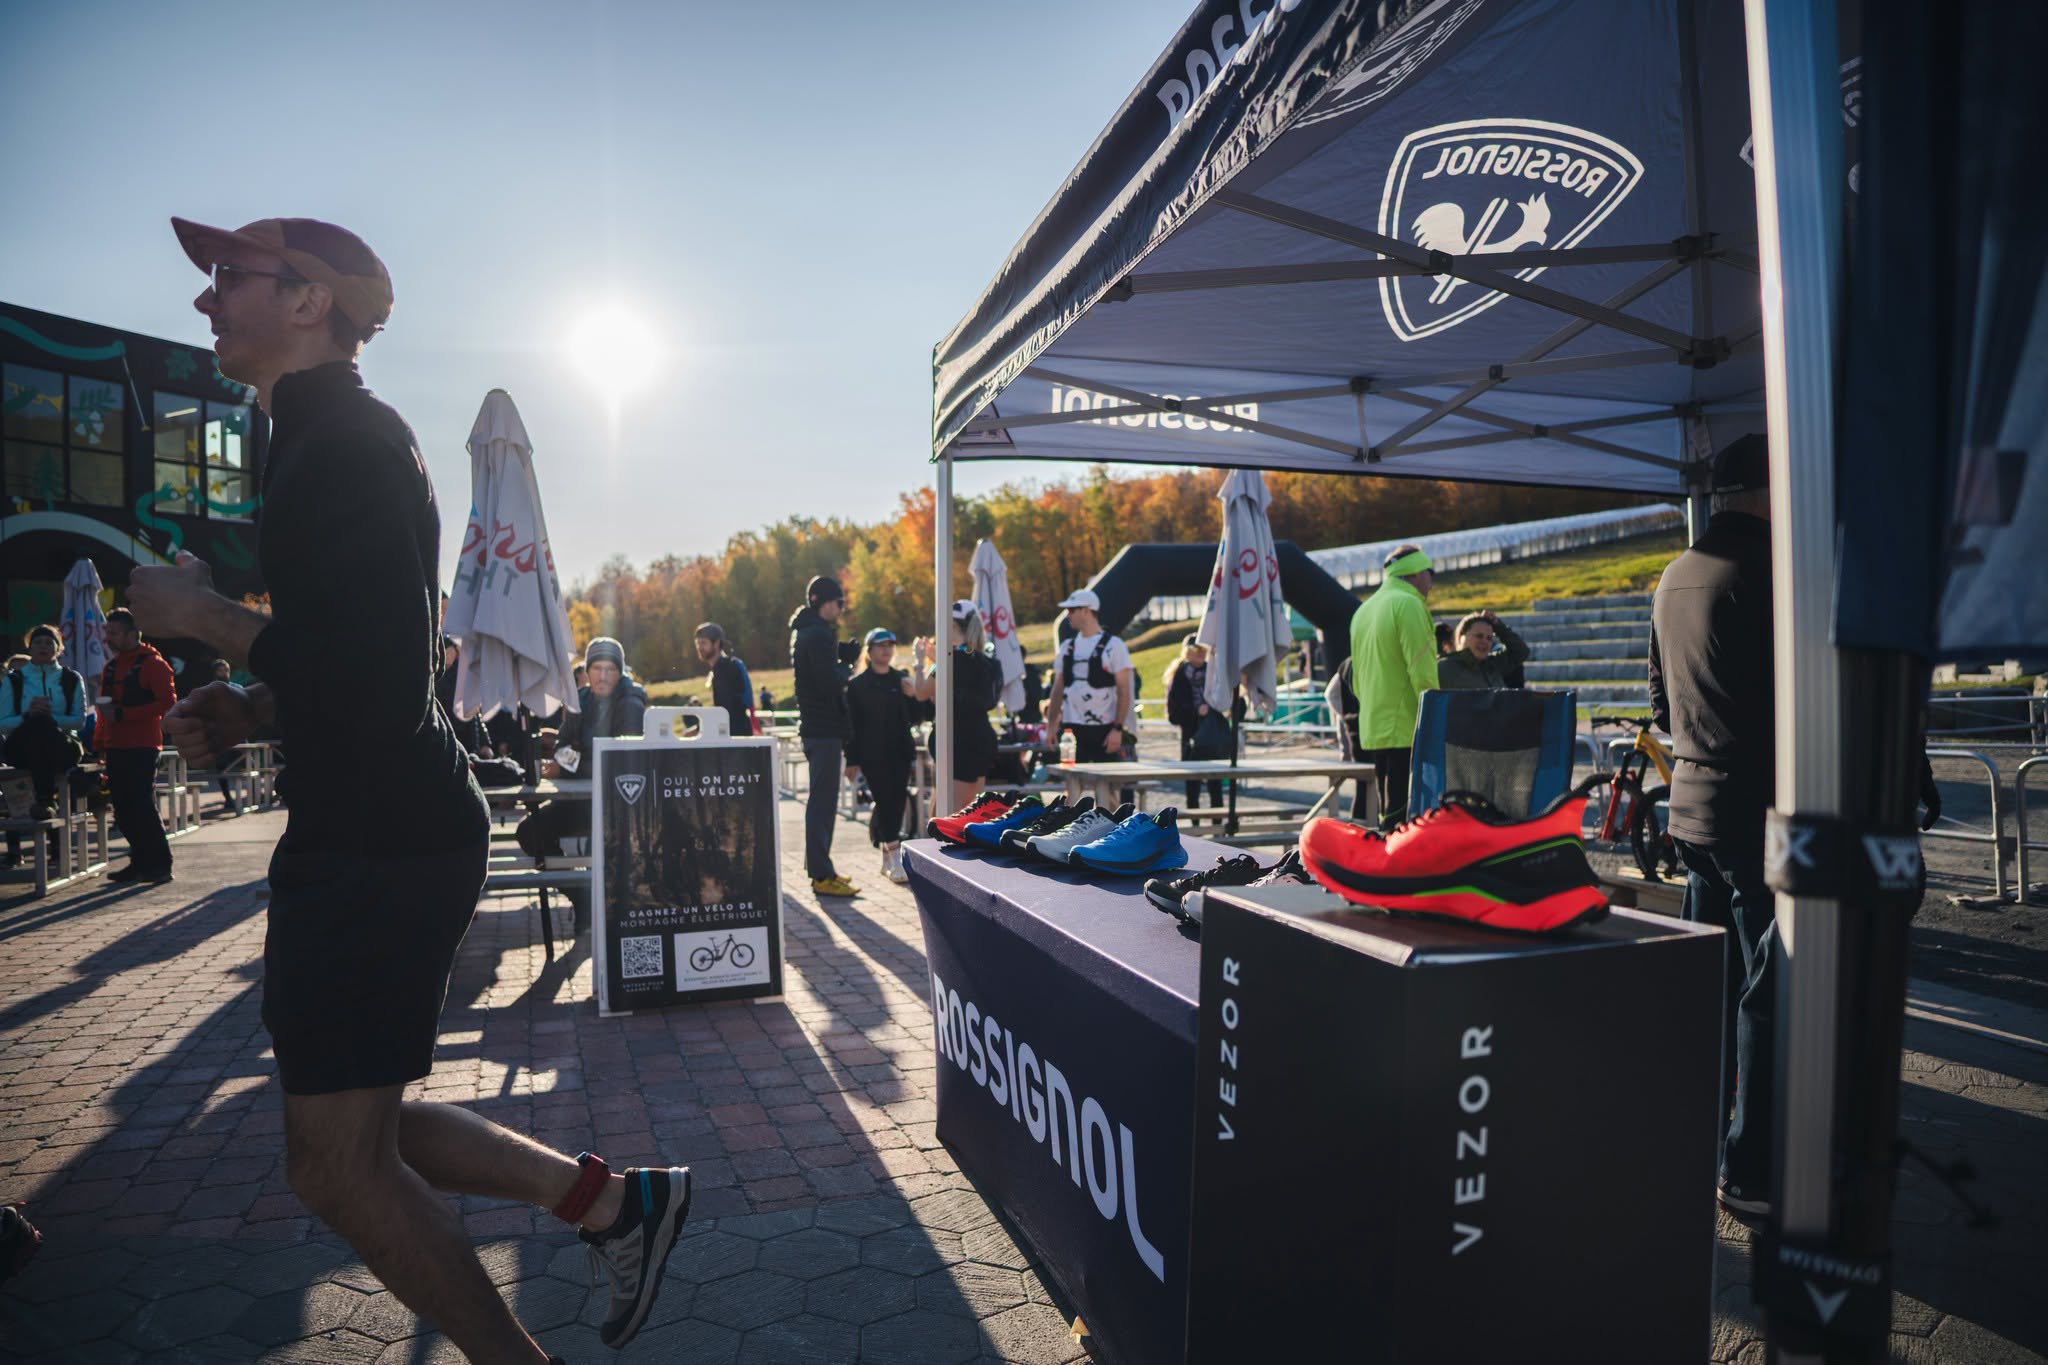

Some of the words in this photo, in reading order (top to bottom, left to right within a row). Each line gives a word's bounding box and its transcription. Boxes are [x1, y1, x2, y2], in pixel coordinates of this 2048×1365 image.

[702, 775, 721, 785] ON
[729, 774, 761, 784] FAIT
[664, 788, 691, 798] DES
[699, 786, 745, 797] VÉLOS
[629, 907, 677, 918] GAGNEZ
[683, 905, 699, 914] UN
[739, 902, 754, 910] DE
[620, 916, 685, 928] MONTAGNE
[1218, 956, 1241, 1141] VEZOR
[933, 972, 1165, 1284] ROSSIGNOL
[1451, 1024, 1493, 1255] VEZOR
